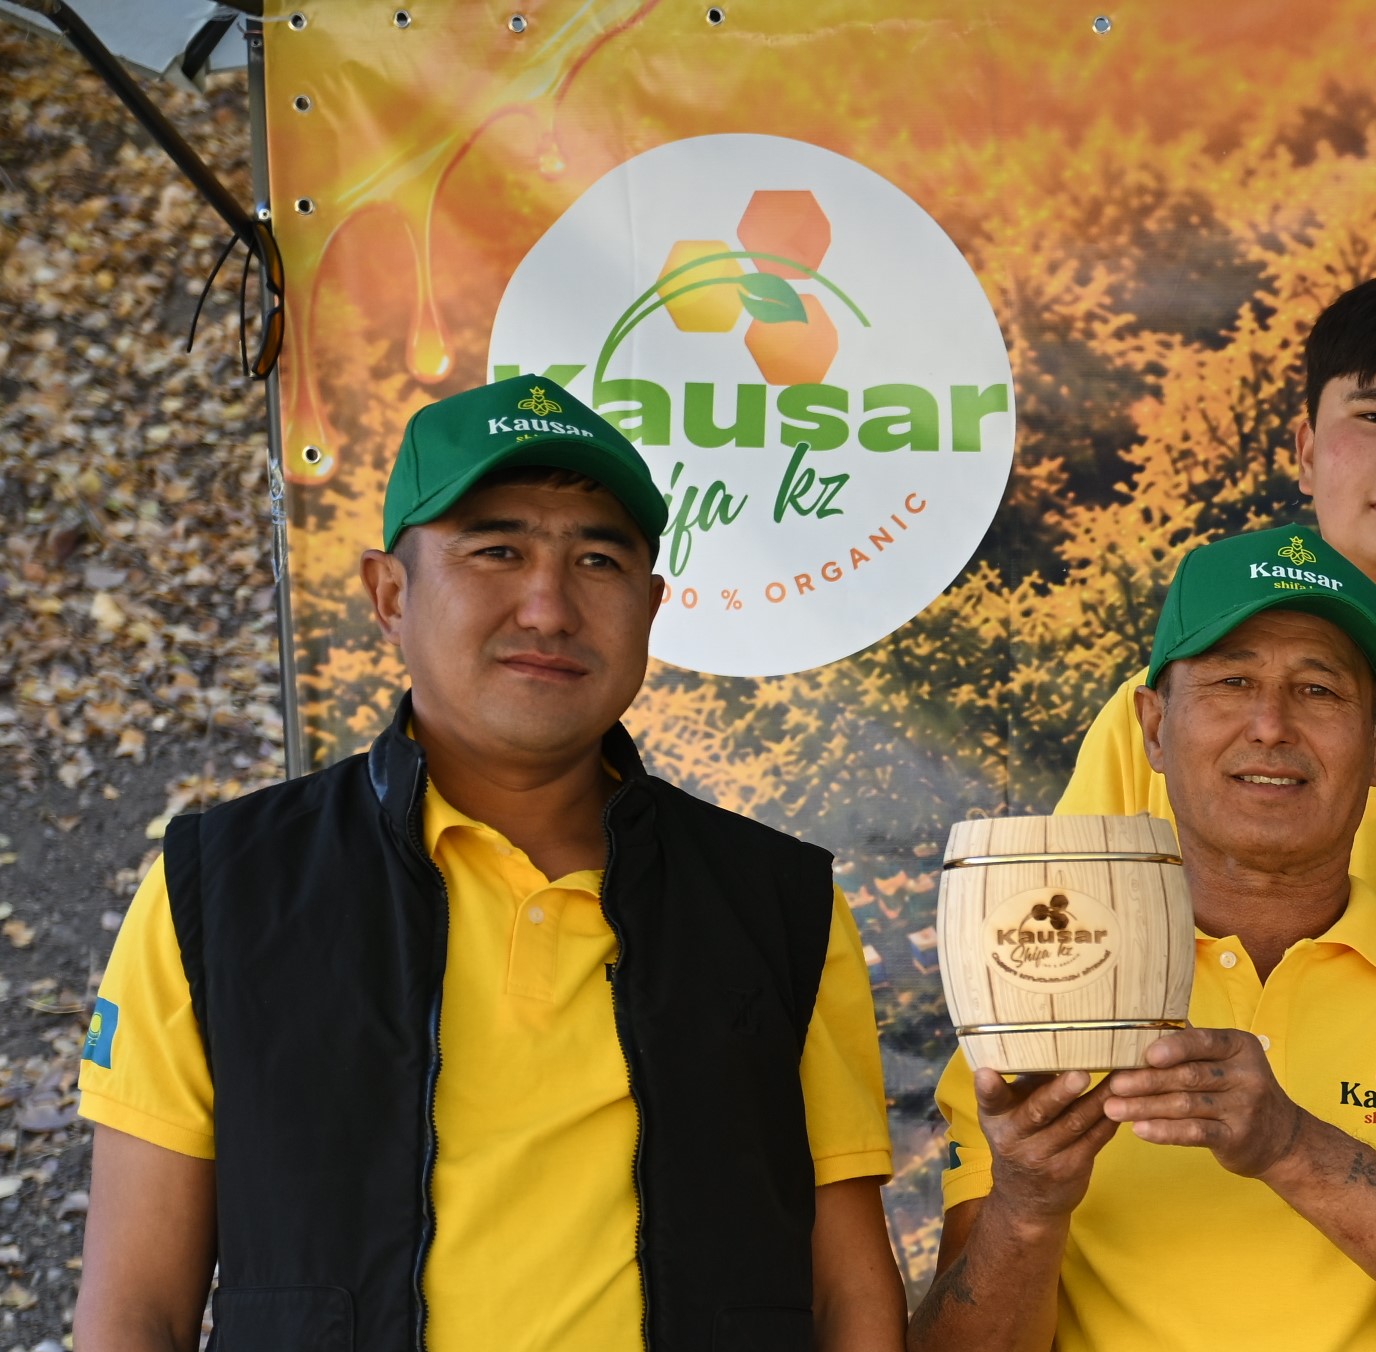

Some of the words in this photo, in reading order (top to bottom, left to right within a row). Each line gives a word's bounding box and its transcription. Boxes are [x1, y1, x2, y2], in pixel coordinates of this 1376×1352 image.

[773, 442, 850, 523] kz
[765, 492, 926, 603] ORGANIC
[1250, 562, 1343, 591] Kausar
[997, 928, 1108, 945] Kausar
